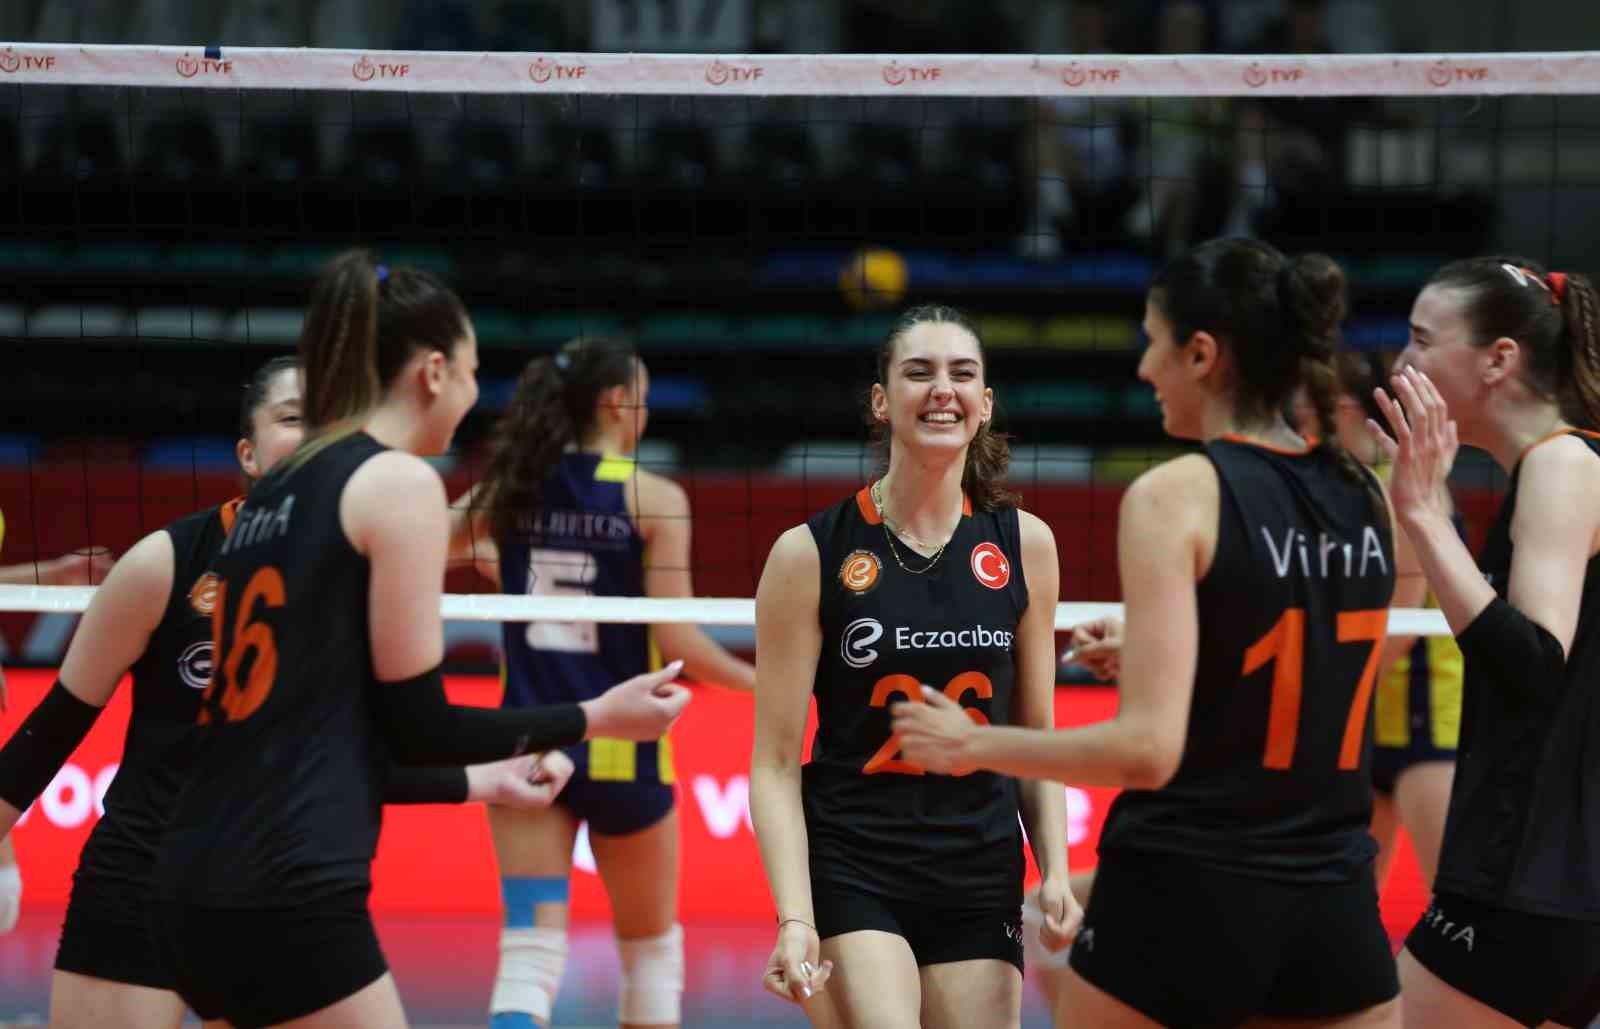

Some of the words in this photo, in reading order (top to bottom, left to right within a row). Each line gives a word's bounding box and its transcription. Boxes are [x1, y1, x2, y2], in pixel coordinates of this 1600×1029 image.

[22, 56, 56, 69] TVF
[201, 60, 233, 74] TVF
[378, 64, 410, 77] TVF
[555, 65, 586, 79] TVF
[731, 67, 763, 81] TVF
[909, 67, 941, 81] TVF
[1088, 69, 1121, 82] TVF
[1271, 69, 1304, 82] TVF
[1455, 67, 1488, 80] TVF
[196, 564, 289, 727] 16
[1241, 607, 1388, 770] 17
